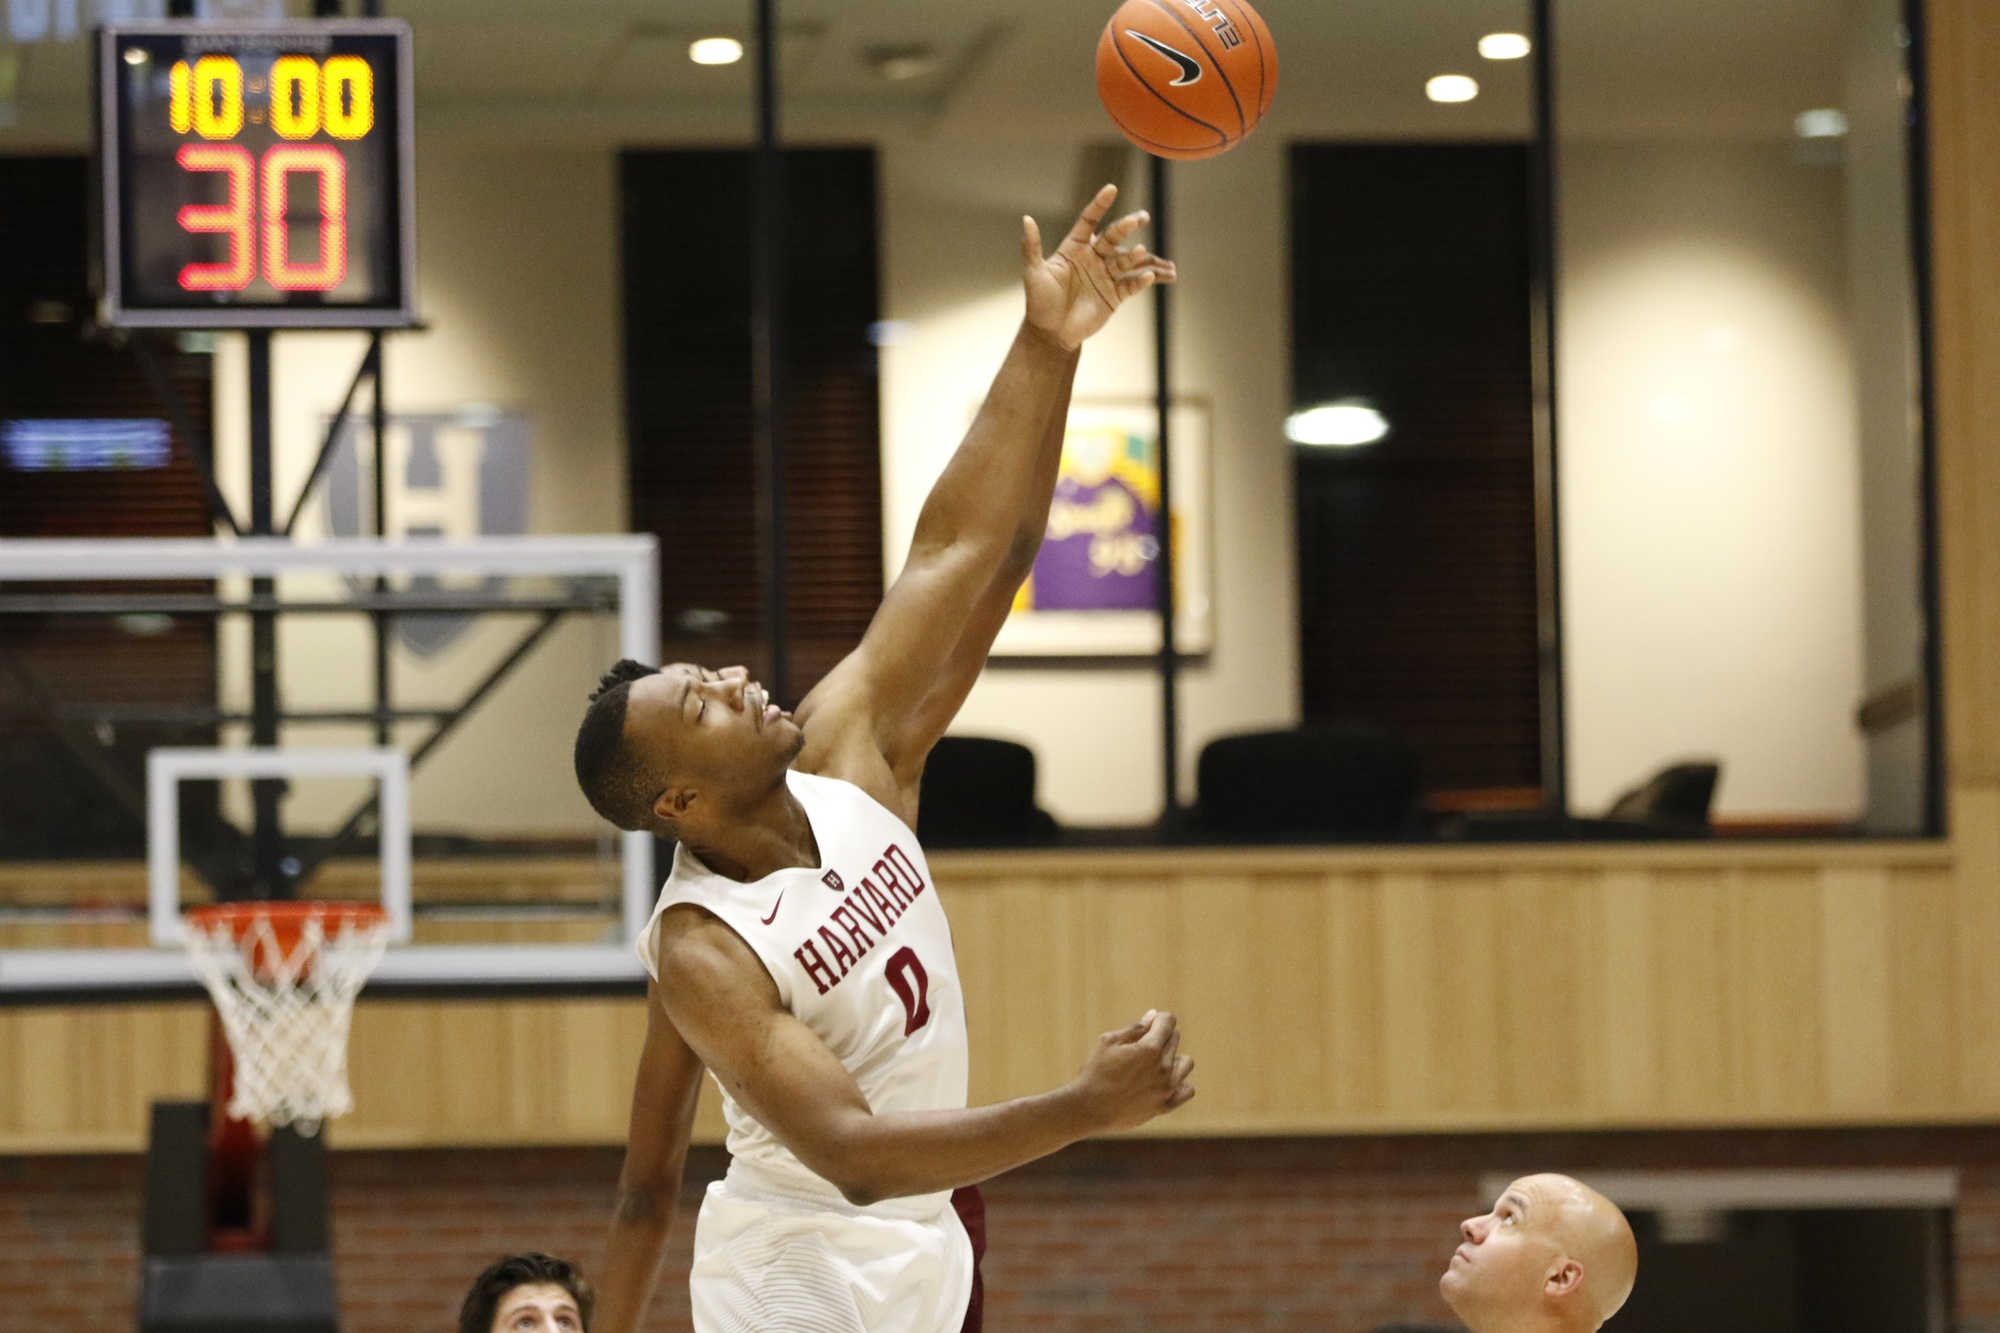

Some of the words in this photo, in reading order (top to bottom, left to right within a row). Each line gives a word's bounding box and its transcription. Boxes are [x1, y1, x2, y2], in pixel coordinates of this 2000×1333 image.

[1183, 0, 1241, 51] ELIT
[169, 54, 375, 140] 10:00
[176, 143, 347, 291] 30
[793, 843, 926, 996] HARVARD
[884, 945, 931, 1038] 0
